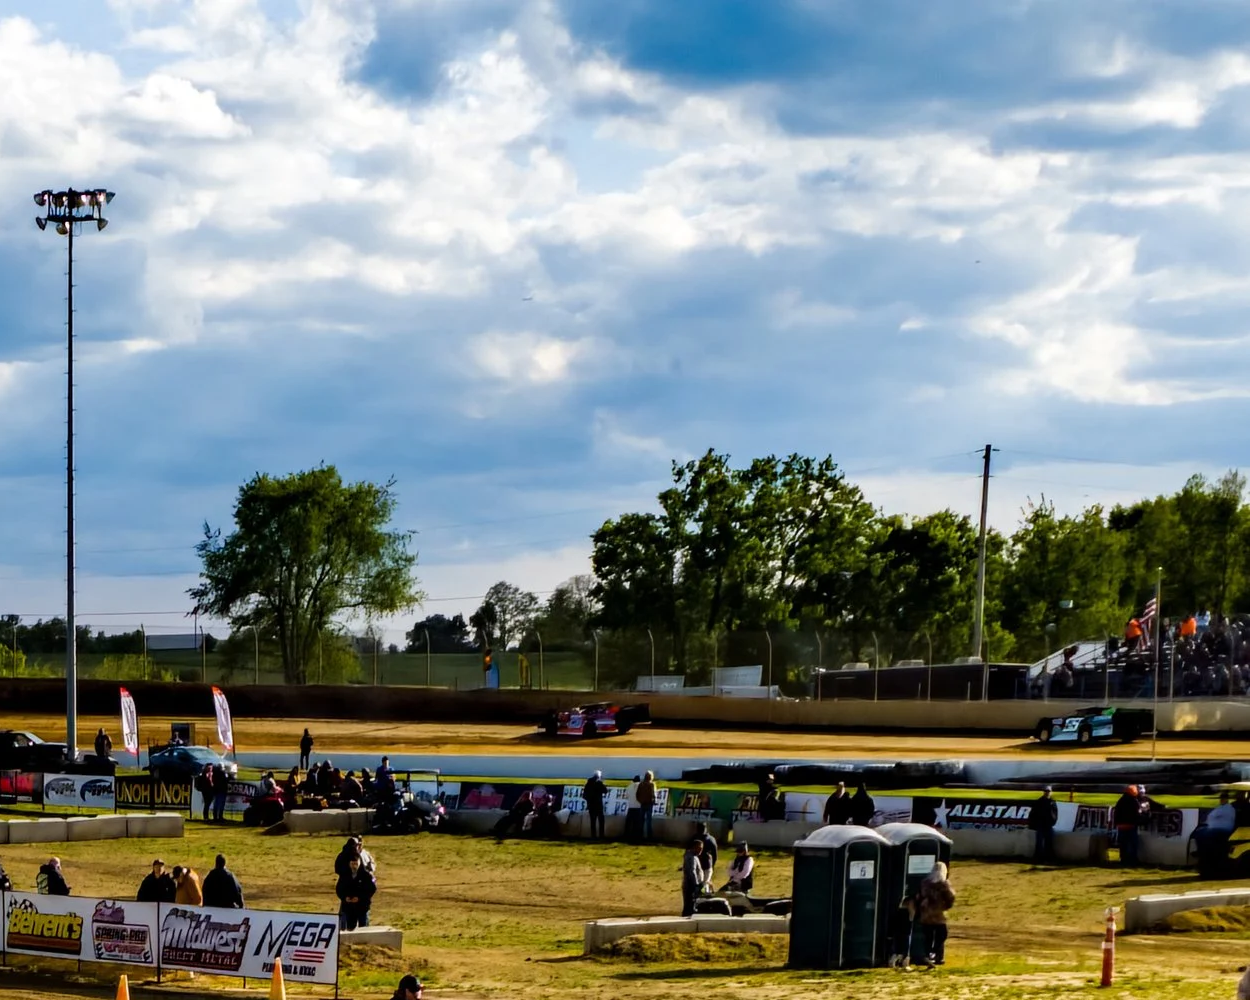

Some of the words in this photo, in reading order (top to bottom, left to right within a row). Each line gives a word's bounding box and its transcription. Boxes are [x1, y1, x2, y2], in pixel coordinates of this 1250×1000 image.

[116, 781, 150, 803] UNOH
[154, 781, 190, 804] UNOH
[950, 804, 1032, 819] ALLSTAR
[162, 912, 250, 953] Midwest
[253, 919, 336, 958] MEGA
[163, 949, 196, 961] SHEET
[200, 952, 238, 966] METAL
